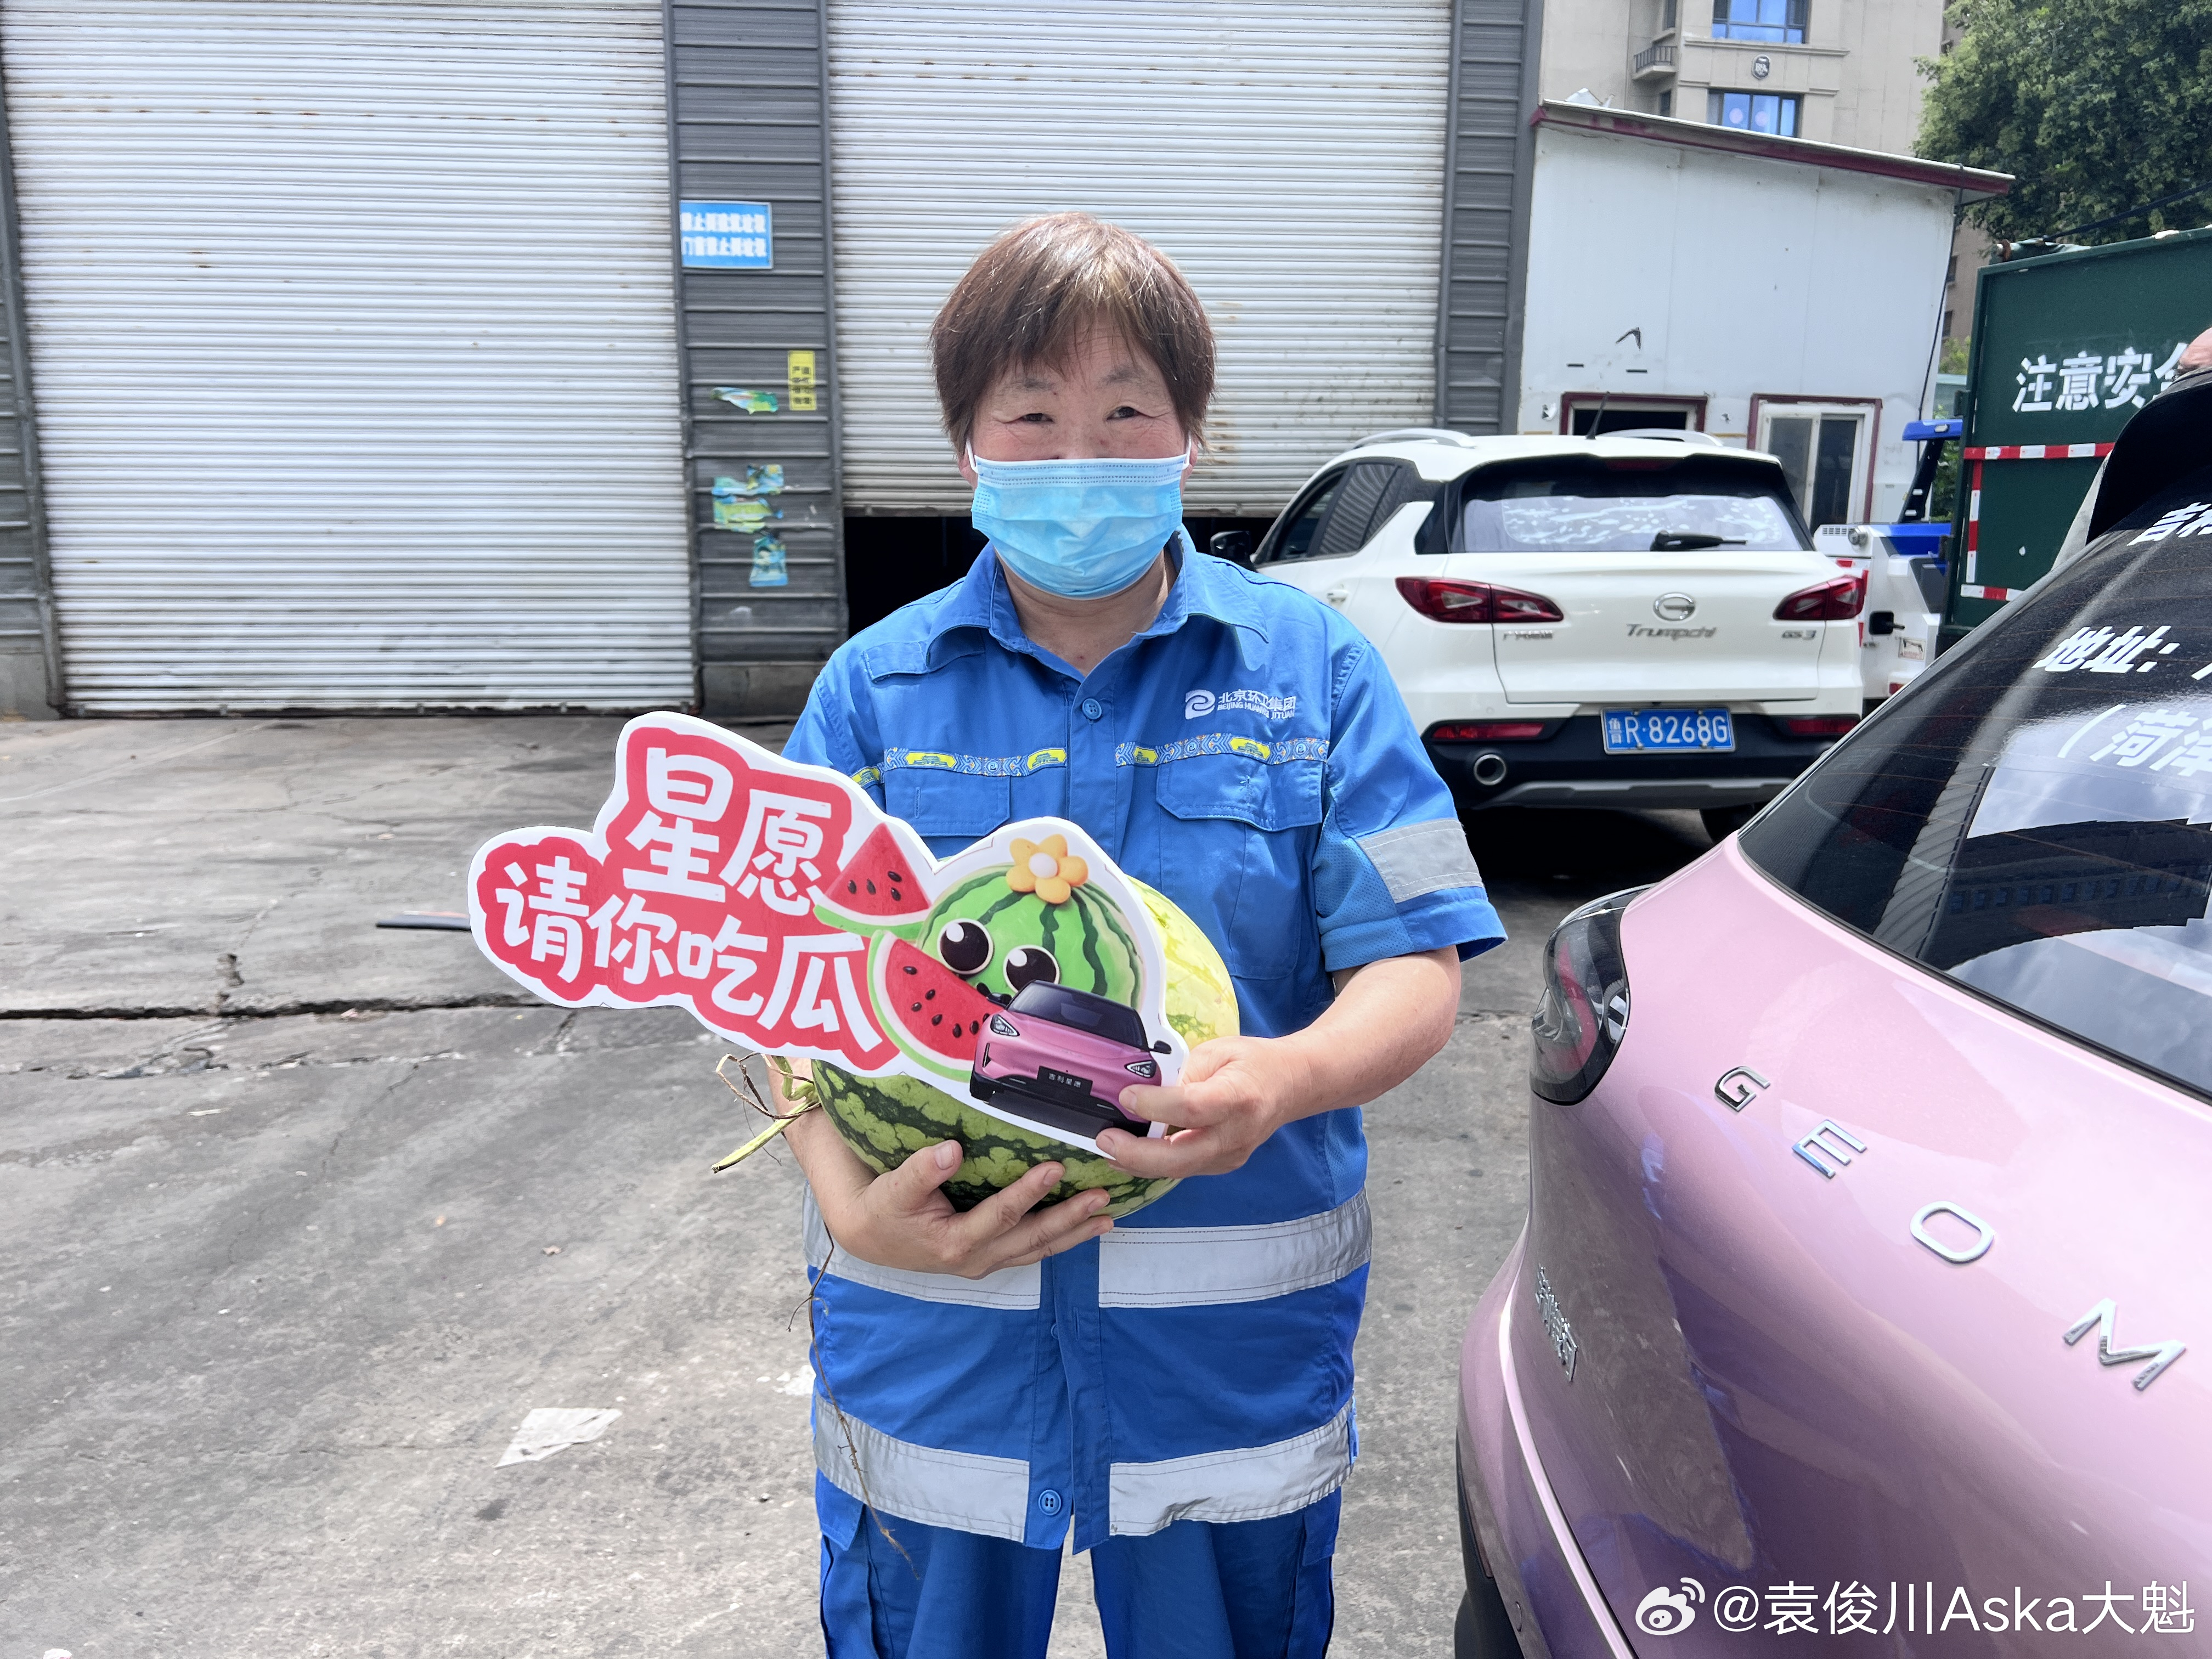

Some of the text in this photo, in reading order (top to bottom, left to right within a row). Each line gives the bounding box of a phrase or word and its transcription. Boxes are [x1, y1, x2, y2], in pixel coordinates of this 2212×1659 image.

[1626, 623, 1717, 641] Trumpchi
[1217, 701, 1244, 711] BEIJING
[623, 747, 831, 916] 星愿
[495, 856, 882, 1053] 请你吃瓜
